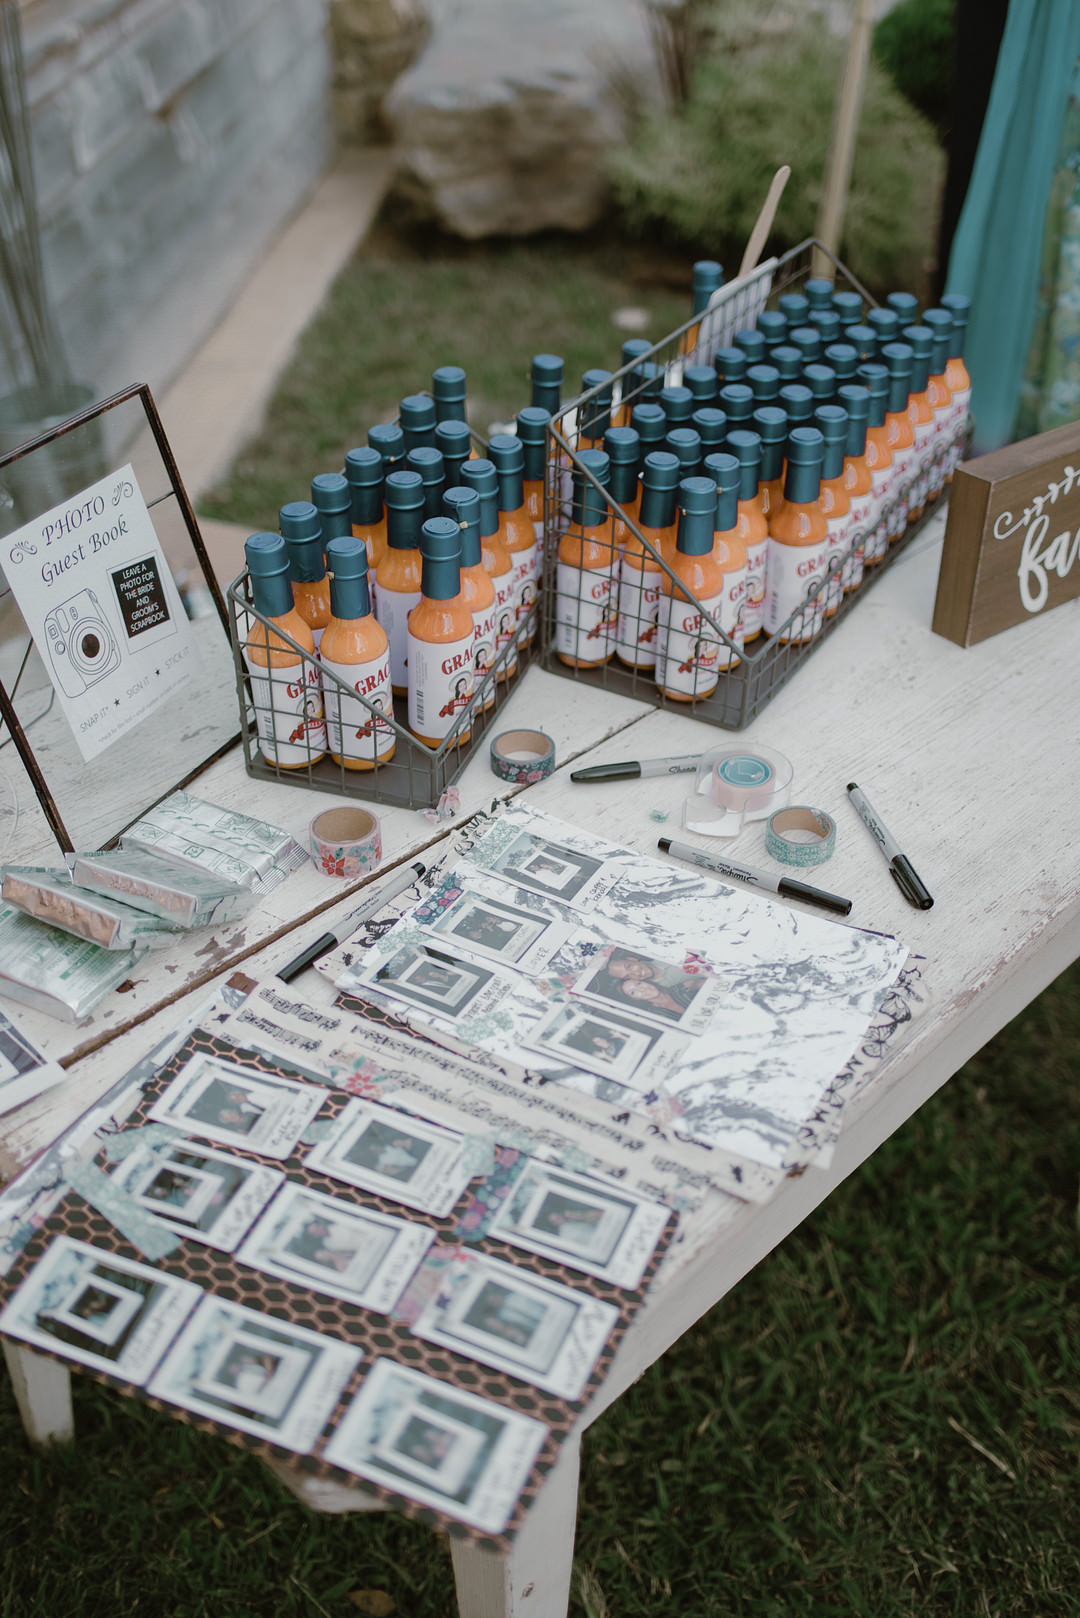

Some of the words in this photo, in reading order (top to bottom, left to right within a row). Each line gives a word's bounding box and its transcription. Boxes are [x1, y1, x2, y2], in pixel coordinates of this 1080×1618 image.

[42, 496, 105, 546] PHOTO
[41, 544, 86, 587] Guest
[89, 513, 129, 553] Book
[122, 565, 142, 579] LEAVE
[141, 563, 147, 572] A
[1018, 514, 1080, 612] fa
[119, 577, 142, 592] PHOTO
[142, 571, 155, 582] FOR
[124, 589, 138, 600] THE
[137, 581, 155, 596] BRIDE
[136, 595, 150, 607] AND
[130, 611, 166, 632] SCRAPBOOK
[80, 713, 99, 733] SNAP
[126, 682, 143, 699] SIGN
